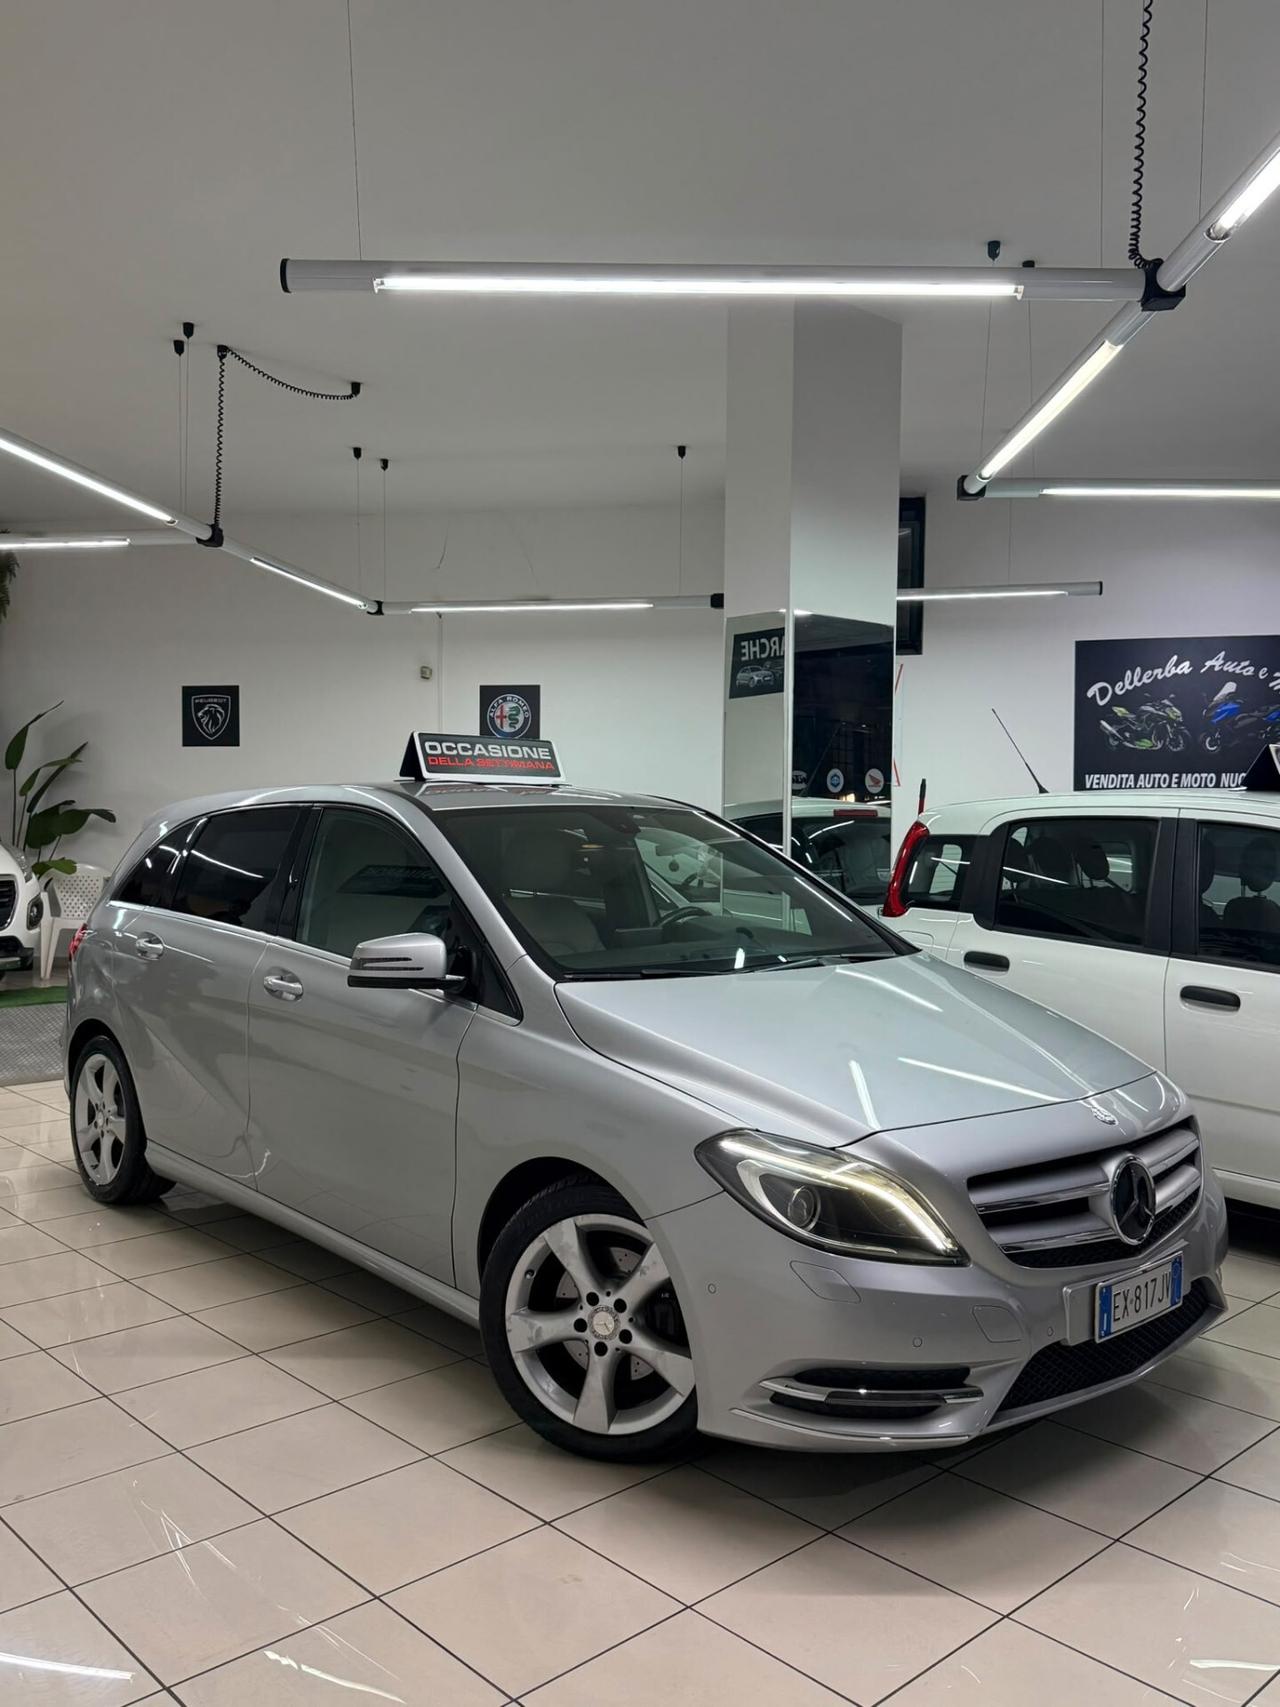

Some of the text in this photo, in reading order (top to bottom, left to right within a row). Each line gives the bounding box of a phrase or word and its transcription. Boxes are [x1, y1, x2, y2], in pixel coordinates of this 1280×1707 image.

[1087, 650, 1269, 706] Dellerba Auto e
[490, 697, 529, 718] ALFA ROMEO
[424, 741, 552, 760] OCCASIONE
[428, 756, 555, 770] DELLA SETTIMANA
[1085, 773, 1134, 789] VENDITA
[1136, 773, 1170, 788] AUTO
[1171, 773, 1178, 788] E
[1180, 773, 1216, 788] MOTO
